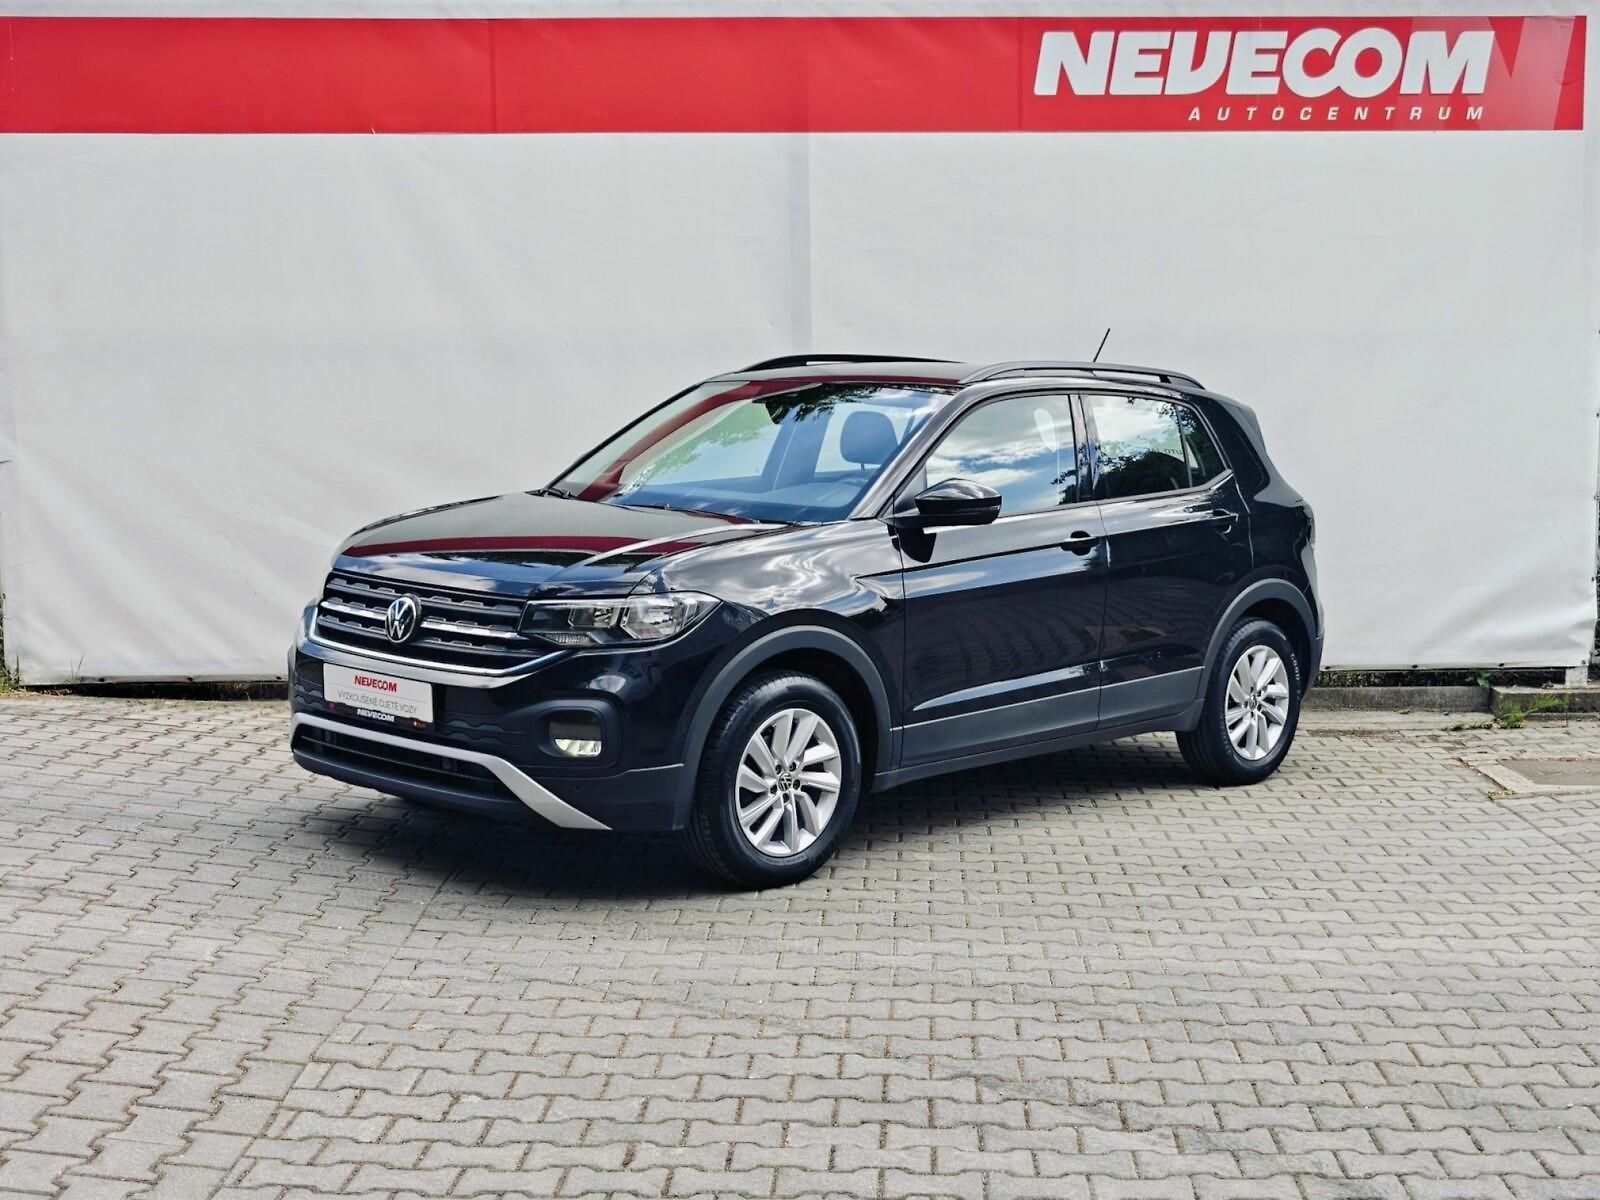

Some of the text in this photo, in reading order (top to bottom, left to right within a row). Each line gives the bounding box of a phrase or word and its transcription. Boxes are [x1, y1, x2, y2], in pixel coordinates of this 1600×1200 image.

[1034, 28, 1494, 97] NEVECOM
[1188, 106, 1483, 121] AUTOCENTRUM
[354, 675, 397, 692] NEVECOM
[357, 708, 395, 722] NEVECOM
[400, 703, 417, 713] VOZY
